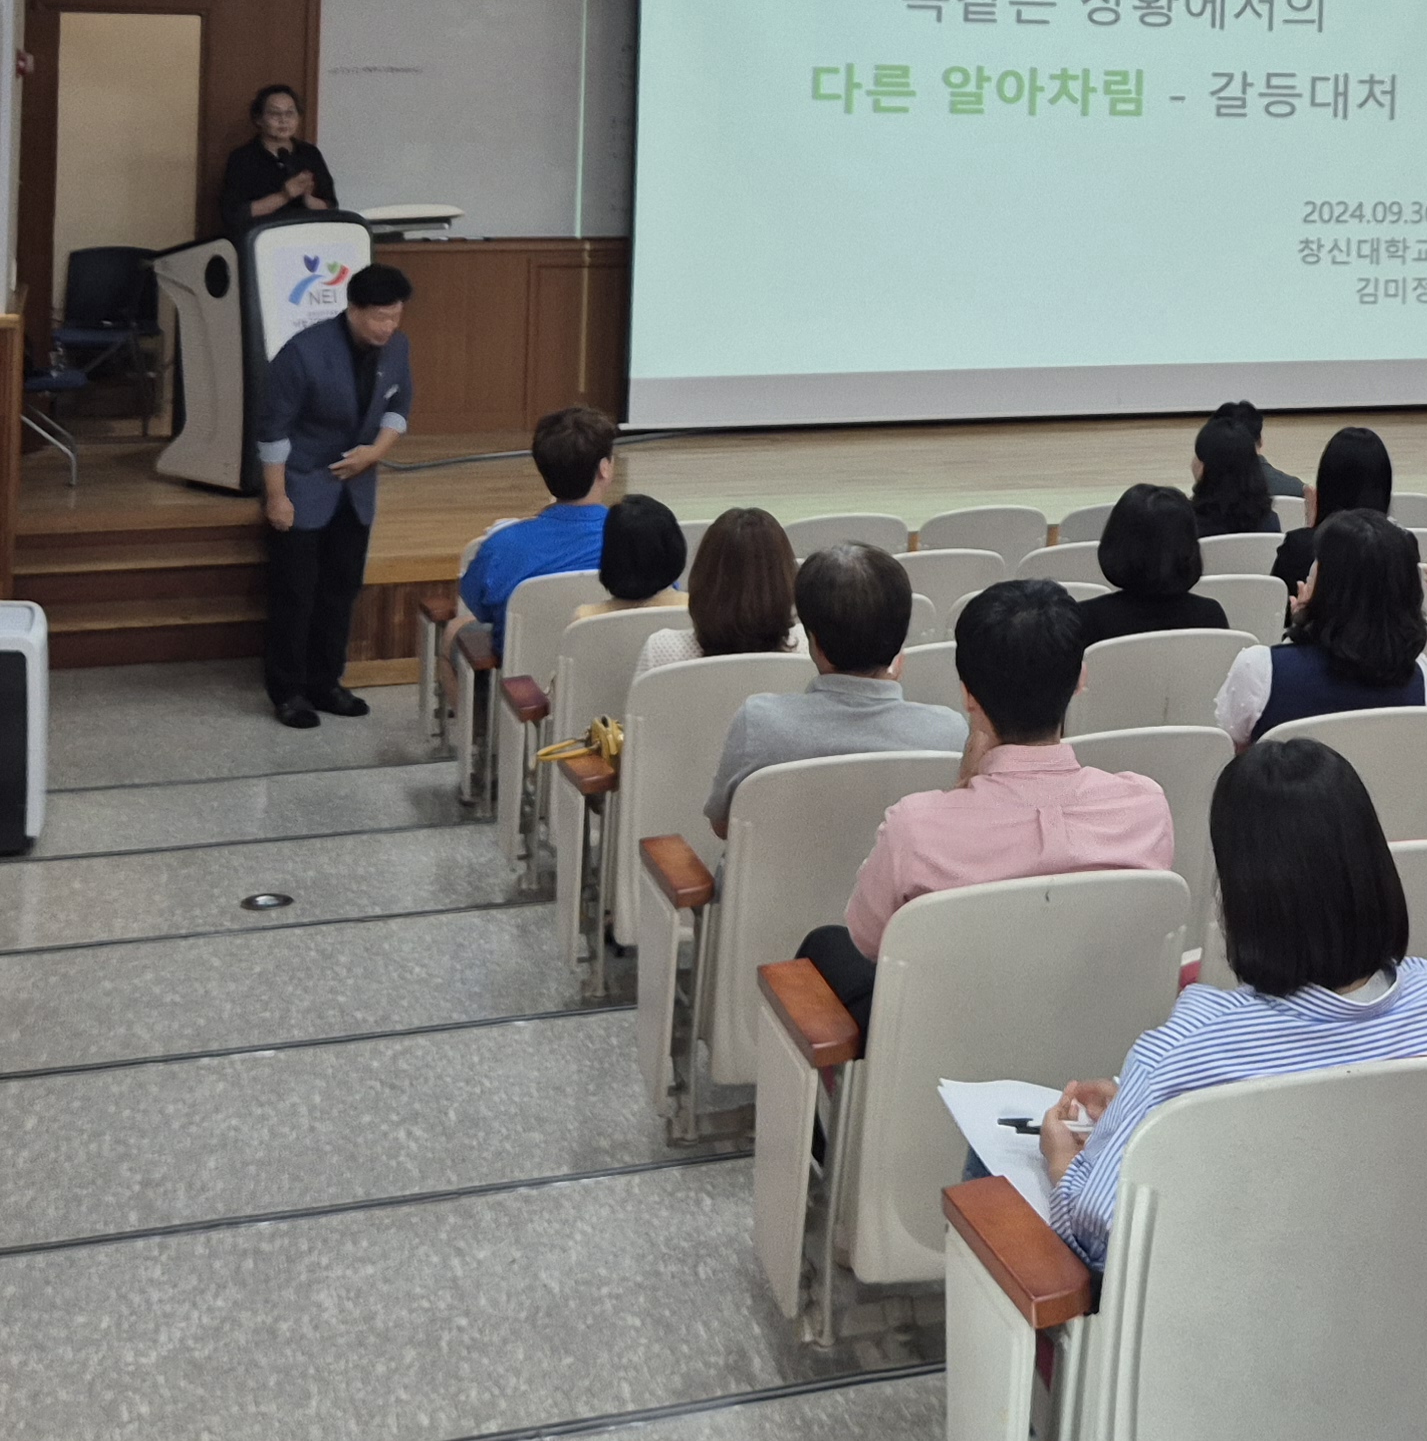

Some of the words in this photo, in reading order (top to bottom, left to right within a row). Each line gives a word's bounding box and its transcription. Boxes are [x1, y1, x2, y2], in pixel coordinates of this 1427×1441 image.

[810, 62, 917, 115] 다른
[941, 64, 1146, 118] 알아차림
[1208, 70, 1399, 121] 갈등대처
